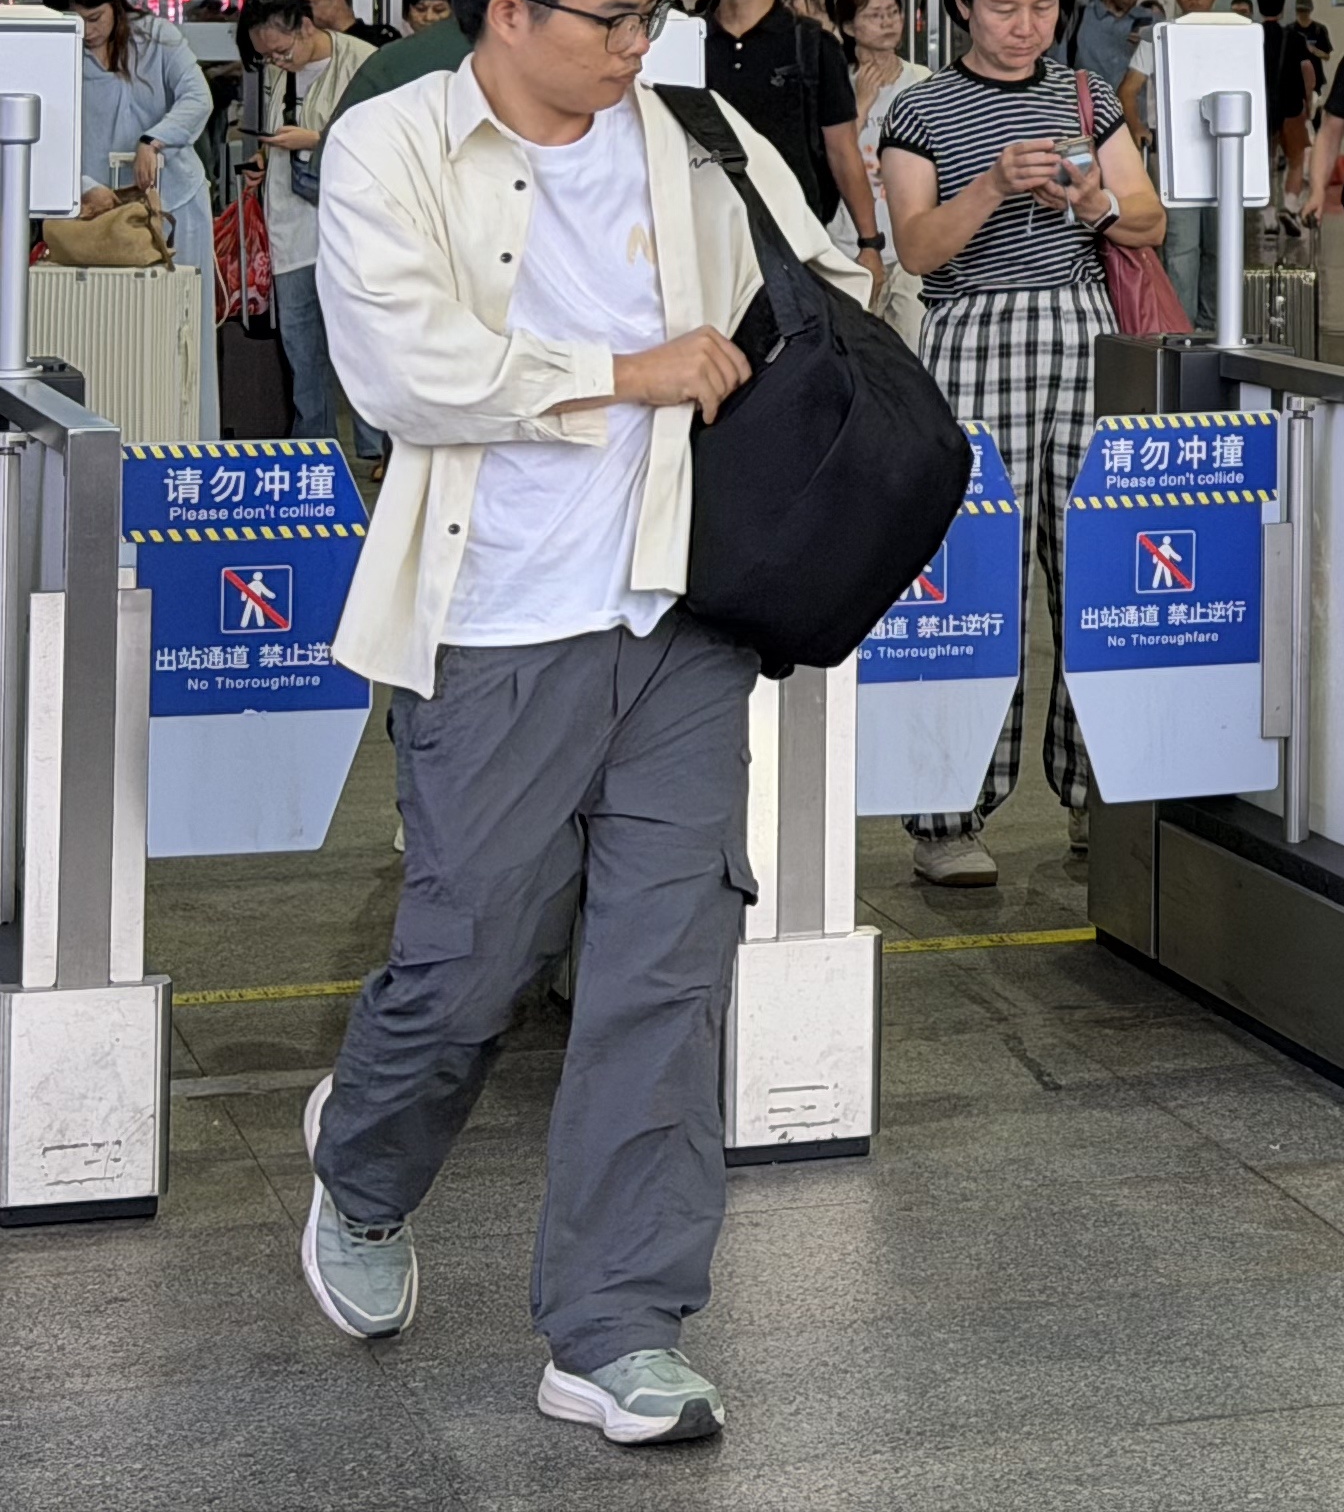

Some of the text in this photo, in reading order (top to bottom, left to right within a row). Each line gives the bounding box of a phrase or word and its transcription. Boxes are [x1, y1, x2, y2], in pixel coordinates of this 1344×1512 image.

[1102, 434, 1244, 472] 请勿冲撞
[164, 464, 335, 504] 请勿冲撞
[1107, 472, 1243, 488] Please don't collide
[170, 504, 335, 520] Please don't collide
[1081, 601, 1246, 629] 出站通道 禁止逆行
[918, 613, 1004, 638] 禁止逆行
[1108, 632, 1218, 646] No Thoroughfare
[156, 642, 337, 670] 出站通道 禁止逆
[878, 645, 973, 658] Thoroughfare
[188, 675, 320, 689] No Thoroughfare
